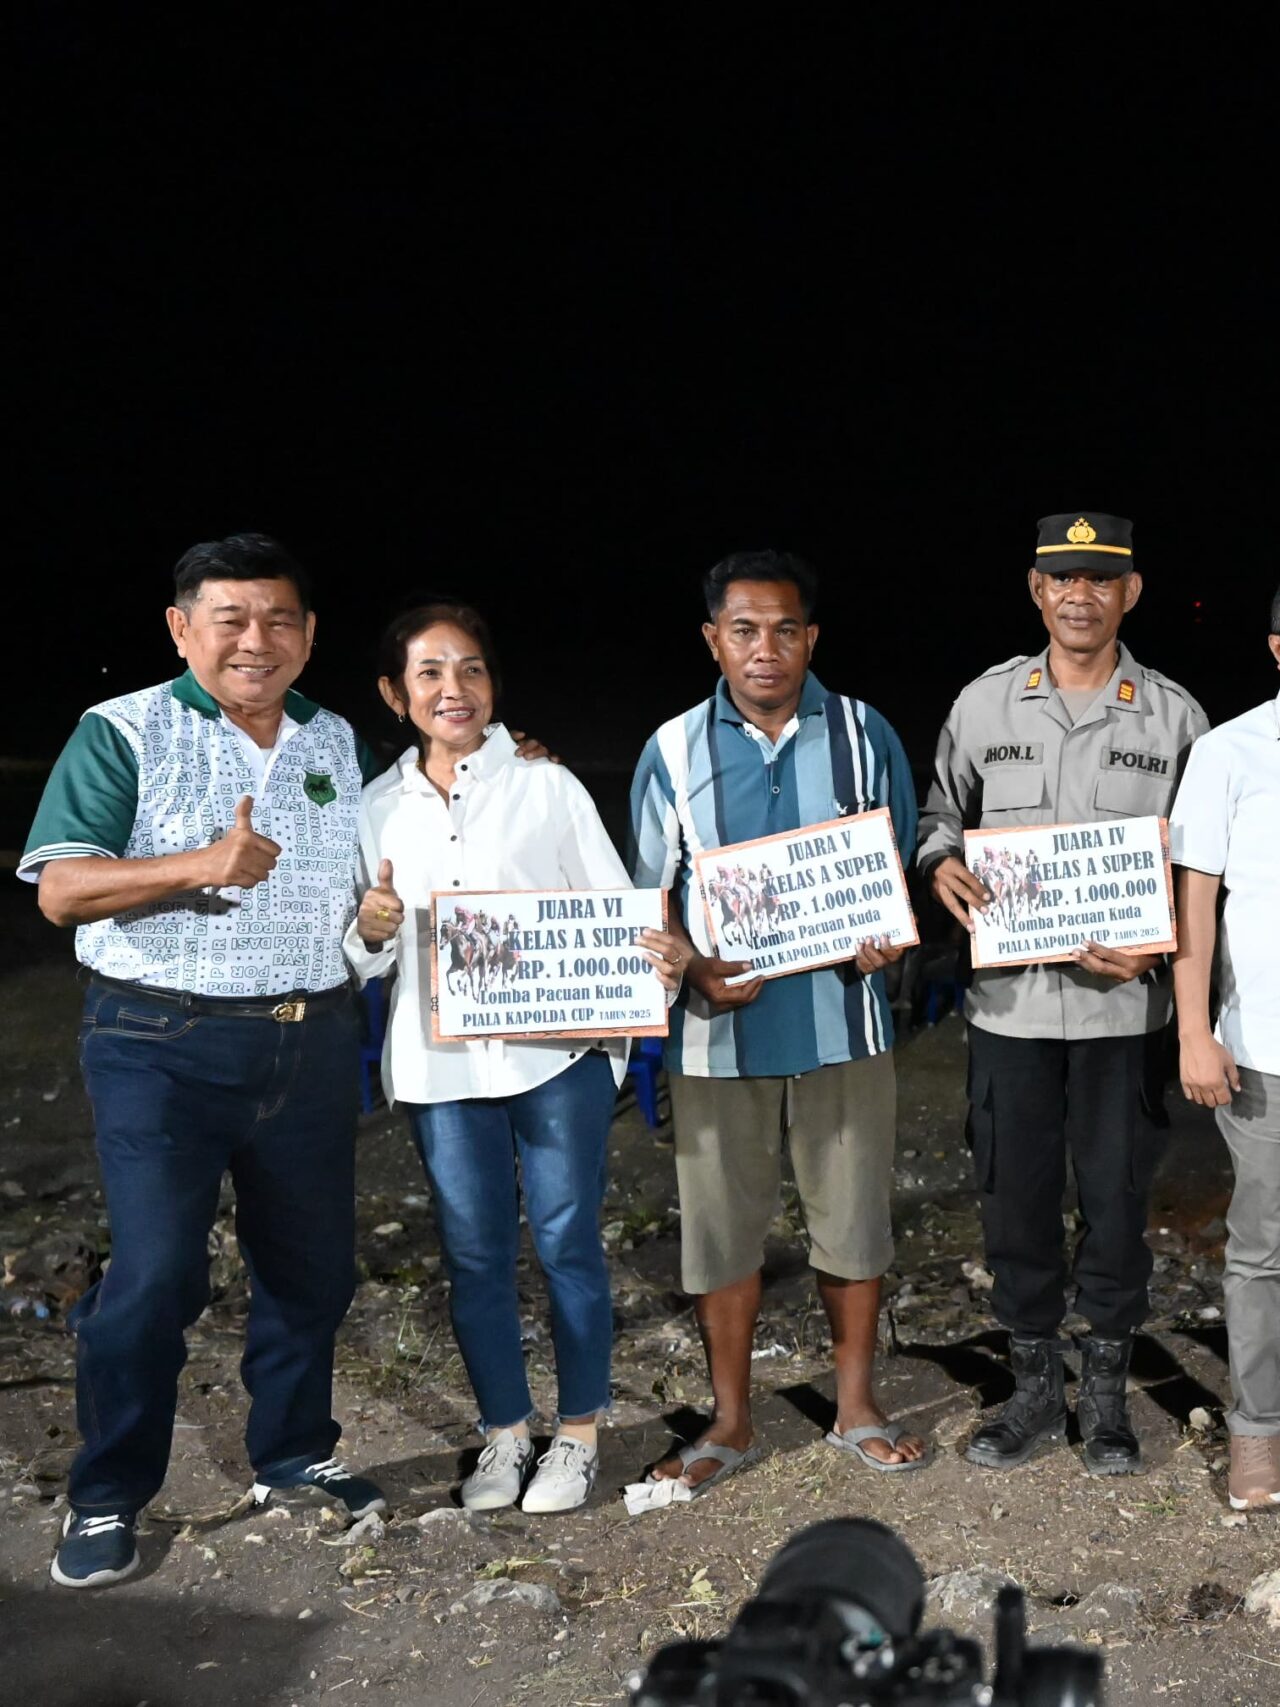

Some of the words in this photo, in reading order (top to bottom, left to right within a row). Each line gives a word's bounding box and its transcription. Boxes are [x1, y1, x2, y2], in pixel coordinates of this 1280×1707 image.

[1108, 750, 1169, 775] POLRI
[271, 797, 306, 812] DASI
[786, 834, 838, 866] JUARA
[841, 830, 852, 850] V
[1052, 828, 1104, 855] JUARA
[1108, 826, 1126, 846] IV
[765, 868, 817, 897] KELAS
[821, 865, 832, 885] A
[834, 851, 888, 880] SUPER
[1030, 860, 1082, 883] KELAS
[1087, 857, 1098, 877] A
[1102, 850, 1155, 875] SUPER
[778, 902, 808, 922] RP.
[811, 879, 893, 915] 1.000.000
[1040, 888, 1070, 908] RP.
[1075, 878, 1157, 905] 1.000.000
[280, 900, 313, 914] POR
[536, 898, 596, 923] JUARA
[603, 897, 623, 919] VI
[1010, 916, 1055, 934] Lomba
[1058, 909, 1105, 928] Pacuan
[1109, 905, 1142, 922] Kuda
[144, 922, 184, 934] DASI
[277, 922, 313, 934] DASI
[508, 929, 567, 951] KELAS
[574, 928, 586, 949] A
[752, 930, 796, 950] Lomba
[799, 917, 845, 939] Pacuan
[849, 907, 881, 927] Kuda
[141, 936, 179, 949] POR
[274, 936, 309, 949] POR
[750, 953, 776, 972] IALA
[779, 942, 830, 965] KAPOLDA
[833, 935, 852, 952] CUP
[998, 940, 1031, 955] PIALA
[1034, 932, 1086, 950] KAPOLDA
[1090, 929, 1111, 943] CUP
[1114, 930, 1138, 941] TAHUN
[1140, 927, 1160, 938] 2025
[182, 938, 198, 990] ORDASI
[273, 954, 309, 966] DASI
[308, 937, 324, 992] ORDASI
[517, 959, 551, 980] RP.
[558, 956, 654, 978] 1.000.000
[207, 981, 245, 994] POR
[480, 988, 532, 1006] Lomba
[536, 986, 591, 1003] Pacuan
[595, 984, 633, 1000] Kuda
[462, 1012, 501, 1027] PIALA
[505, 1010, 567, 1025] KAPOLDA
[571, 1008, 595, 1022] CUP
[599, 1010, 626, 1021] TAHUN
[628, 1009, 651, 1020] 2025
